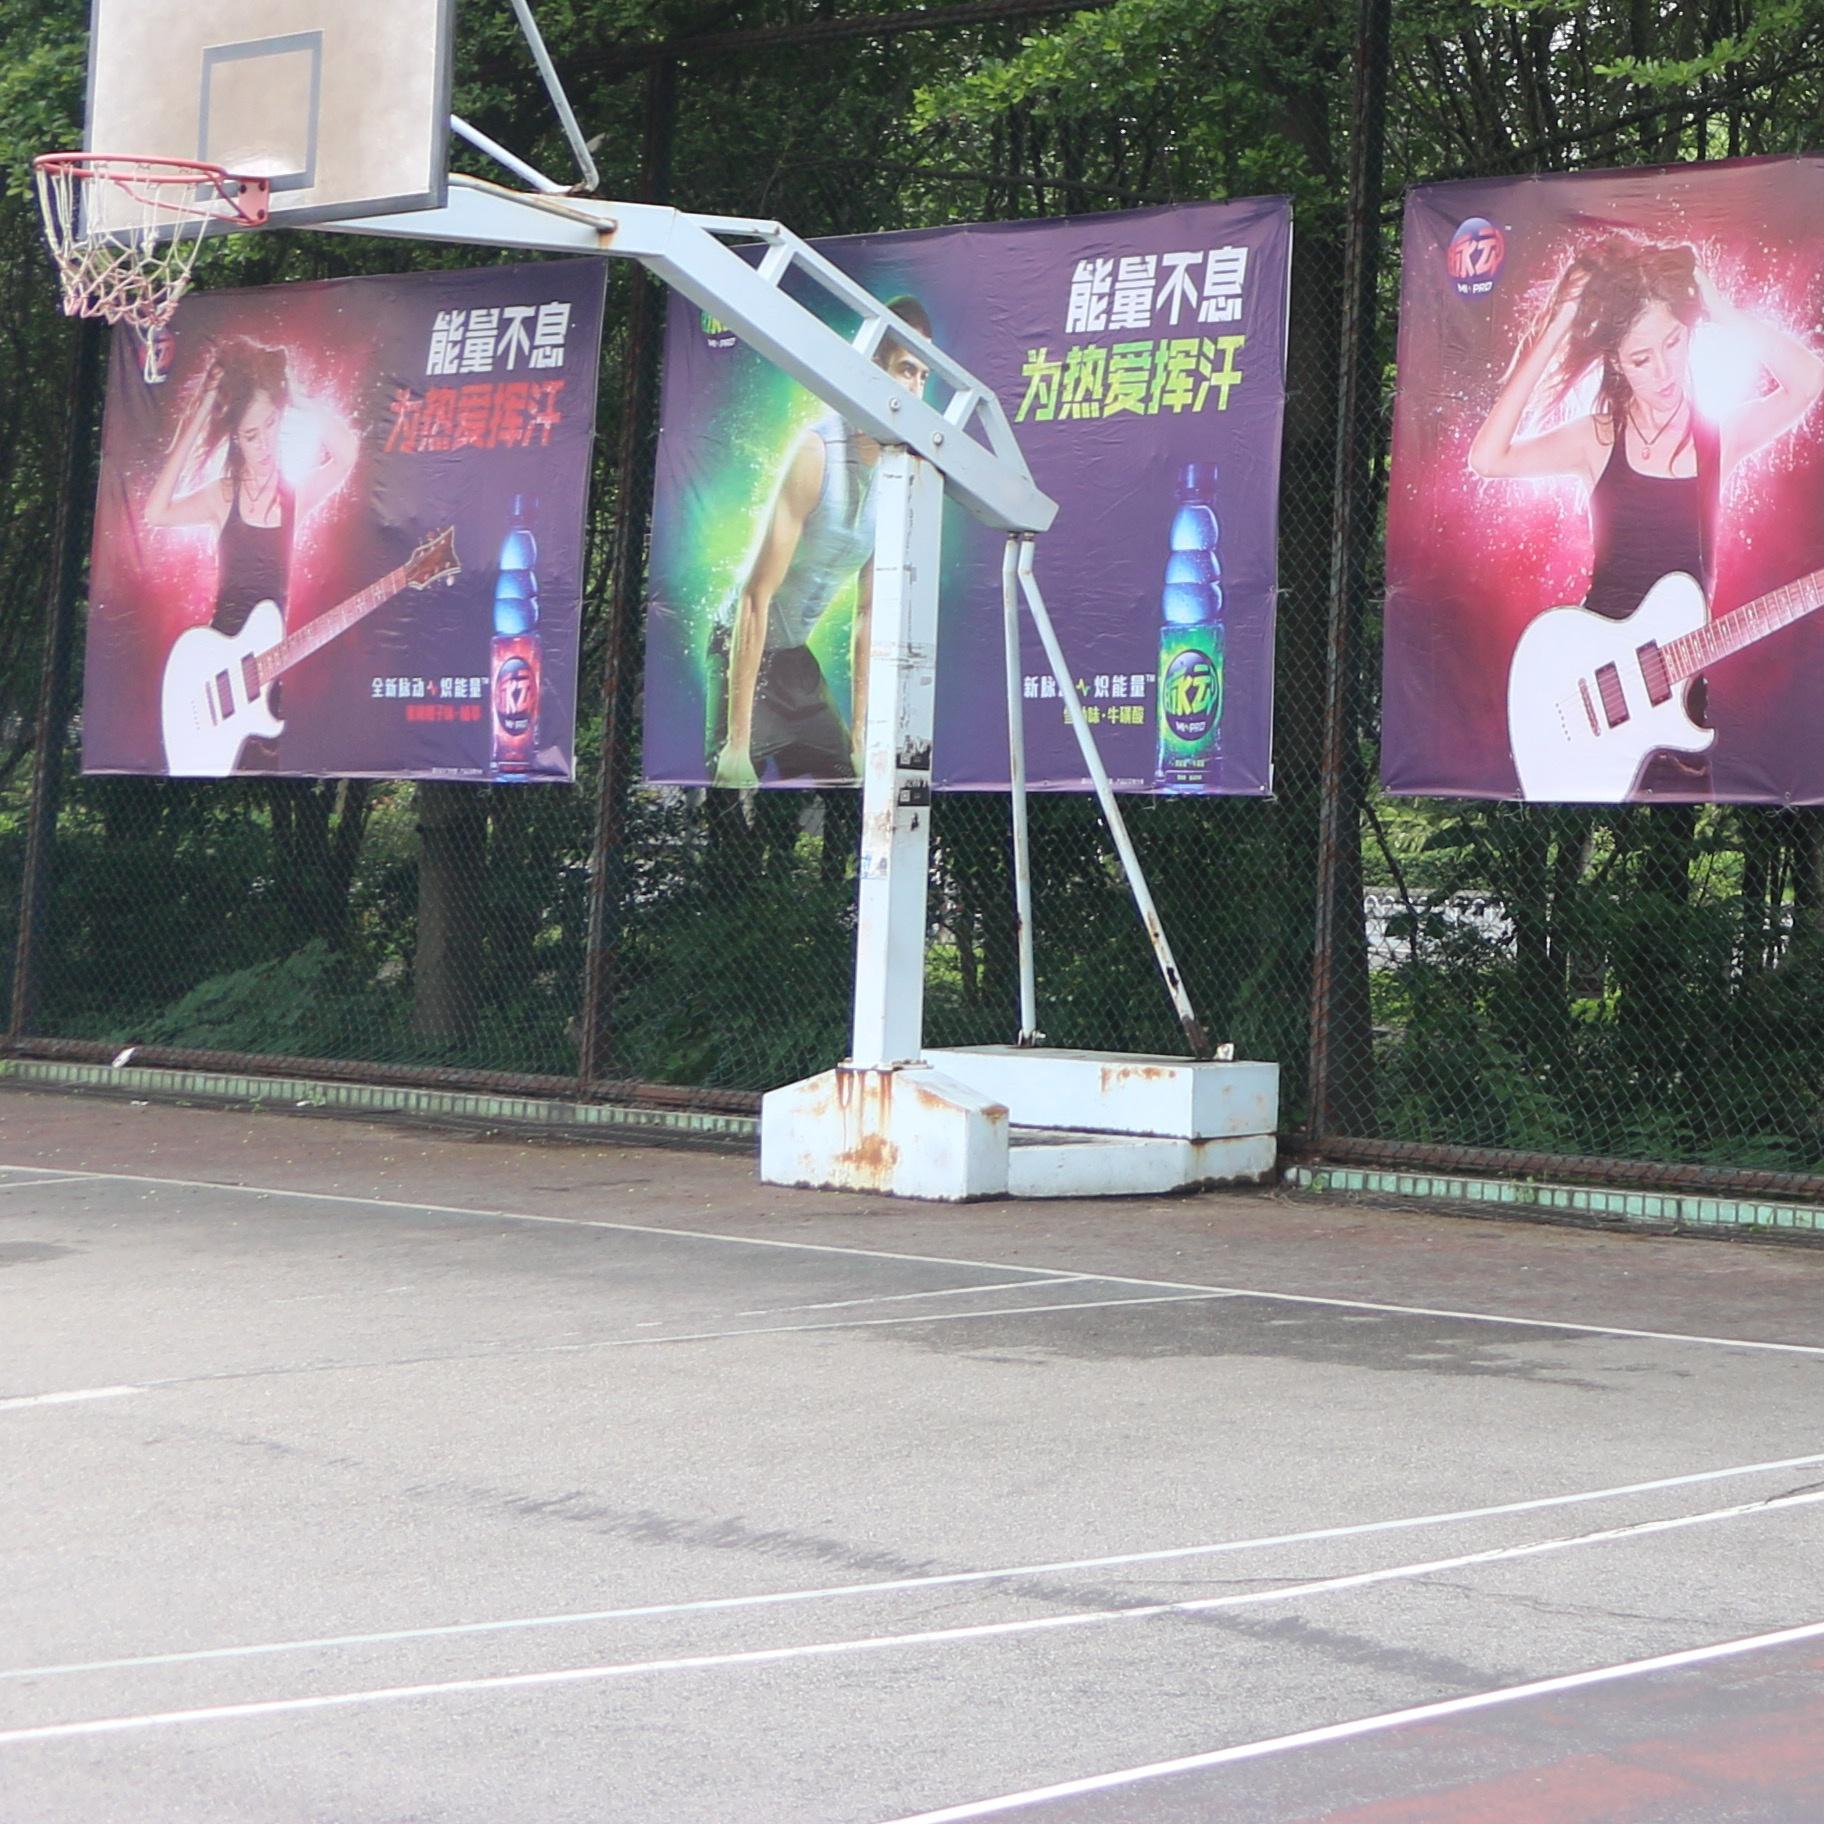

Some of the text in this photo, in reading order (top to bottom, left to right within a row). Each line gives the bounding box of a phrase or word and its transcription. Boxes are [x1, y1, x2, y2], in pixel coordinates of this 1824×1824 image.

[1065, 246, 1248, 333] 能量不息
[426, 301, 571, 375] 能量不息
[384, 379, 566, 453] 为热爱挥汗
[1014, 334, 1246, 423] 为热爱挥汗
